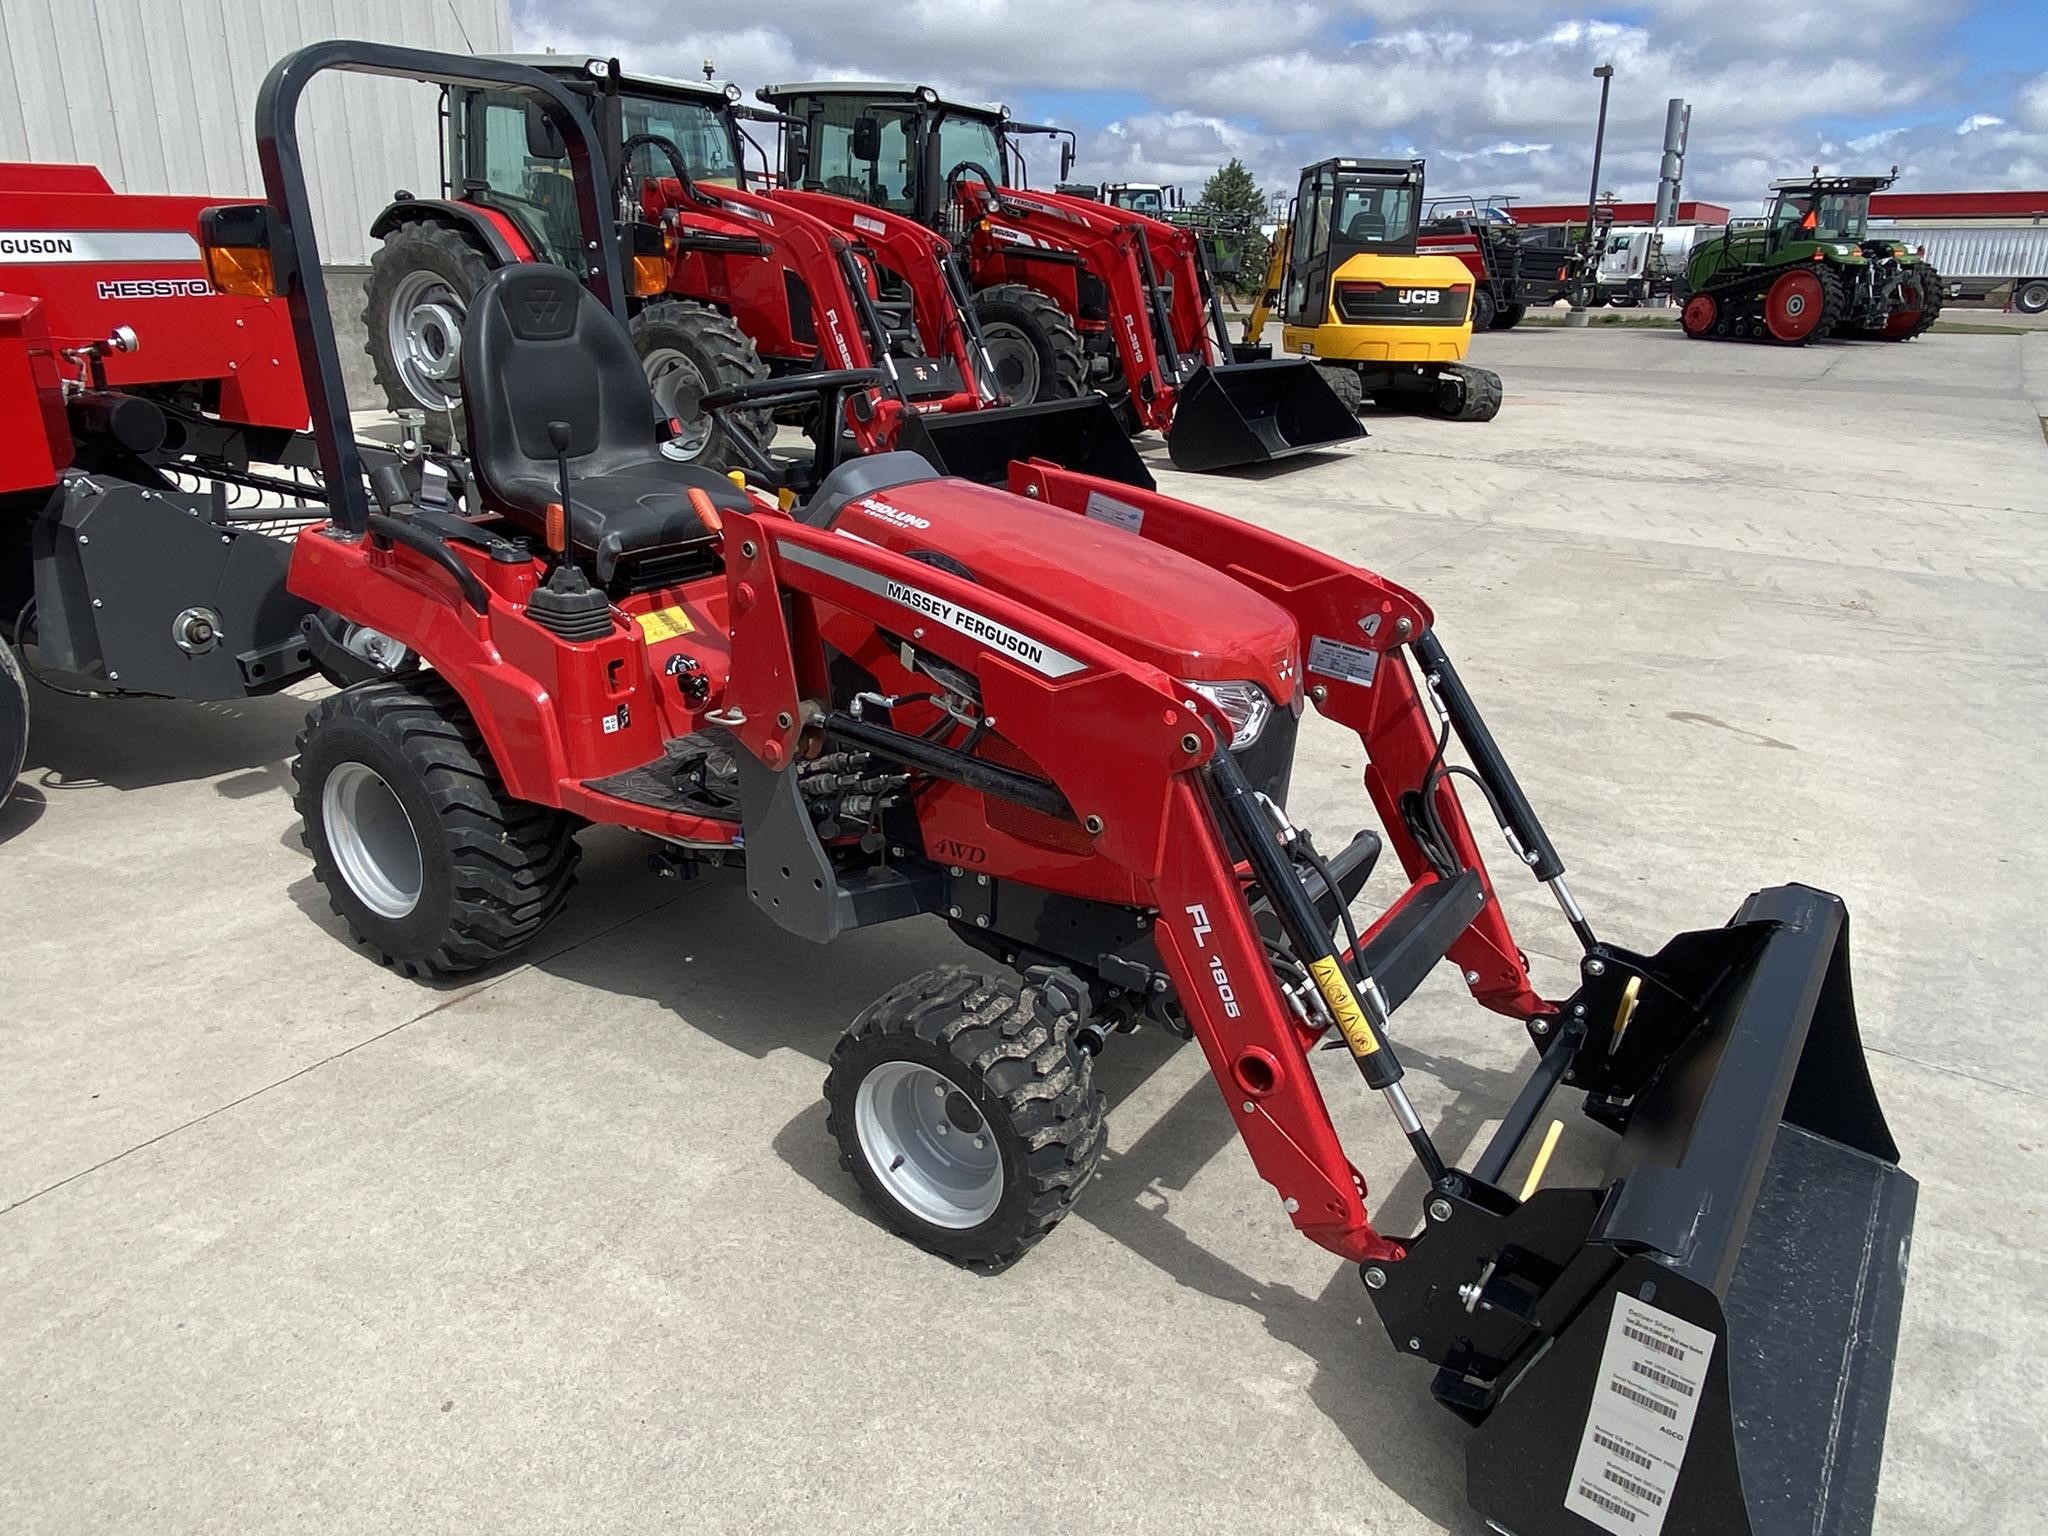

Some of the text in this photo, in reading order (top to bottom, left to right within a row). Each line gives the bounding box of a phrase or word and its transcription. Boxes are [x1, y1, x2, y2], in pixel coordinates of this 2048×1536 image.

[0, 239, 73, 254] GUSON
[97, 280, 217, 299] HESSTO
[1398, 289, 1440, 305] JCB
[859, 499, 931, 529] REDLUND
[888, 583, 1042, 663] MASSEY FERGUSON
[934, 839, 986, 863] 4WD
[1185, 904, 1241, 1018] FL 1805
[1659, 1425, 1684, 1441] AGCO
